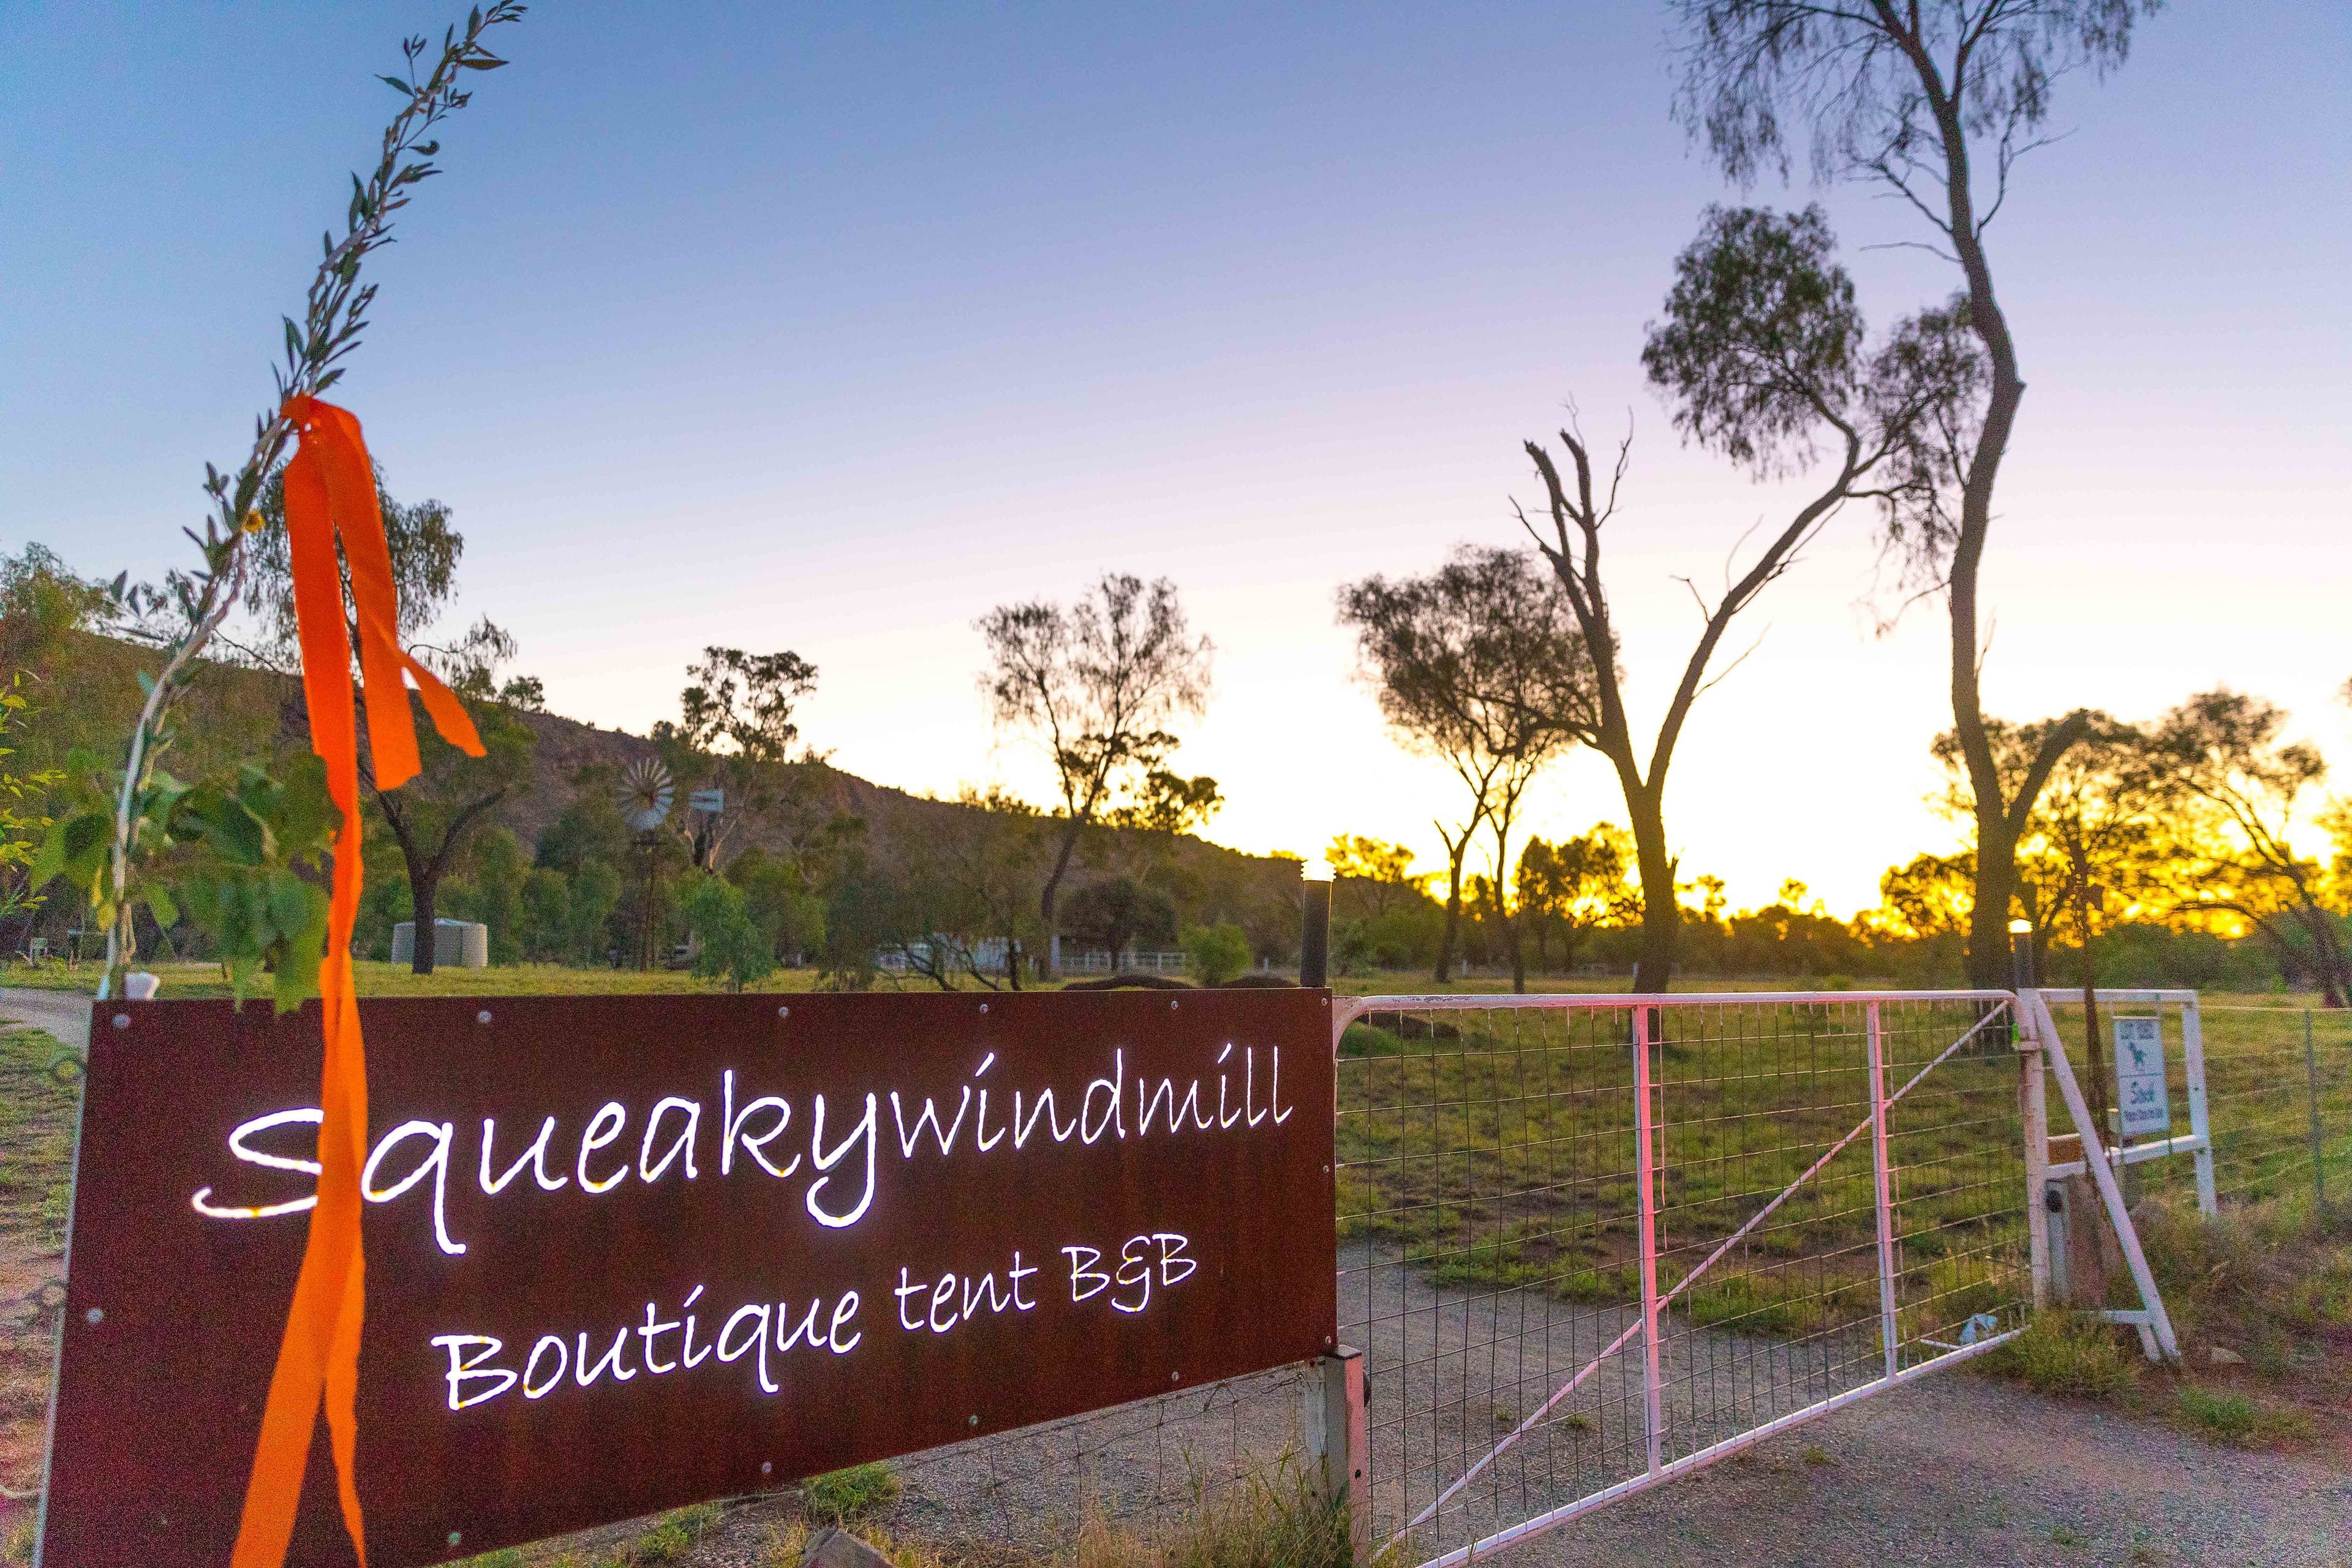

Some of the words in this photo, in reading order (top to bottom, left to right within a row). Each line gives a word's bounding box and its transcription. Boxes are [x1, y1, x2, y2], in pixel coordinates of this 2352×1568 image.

[191, 1042, 1293, 1255] Squeakywindmill
[431, 1284, 862, 1411] Boutique
[894, 1251, 1038, 1333] tent
[1061, 1232, 1197, 1313] B&B
